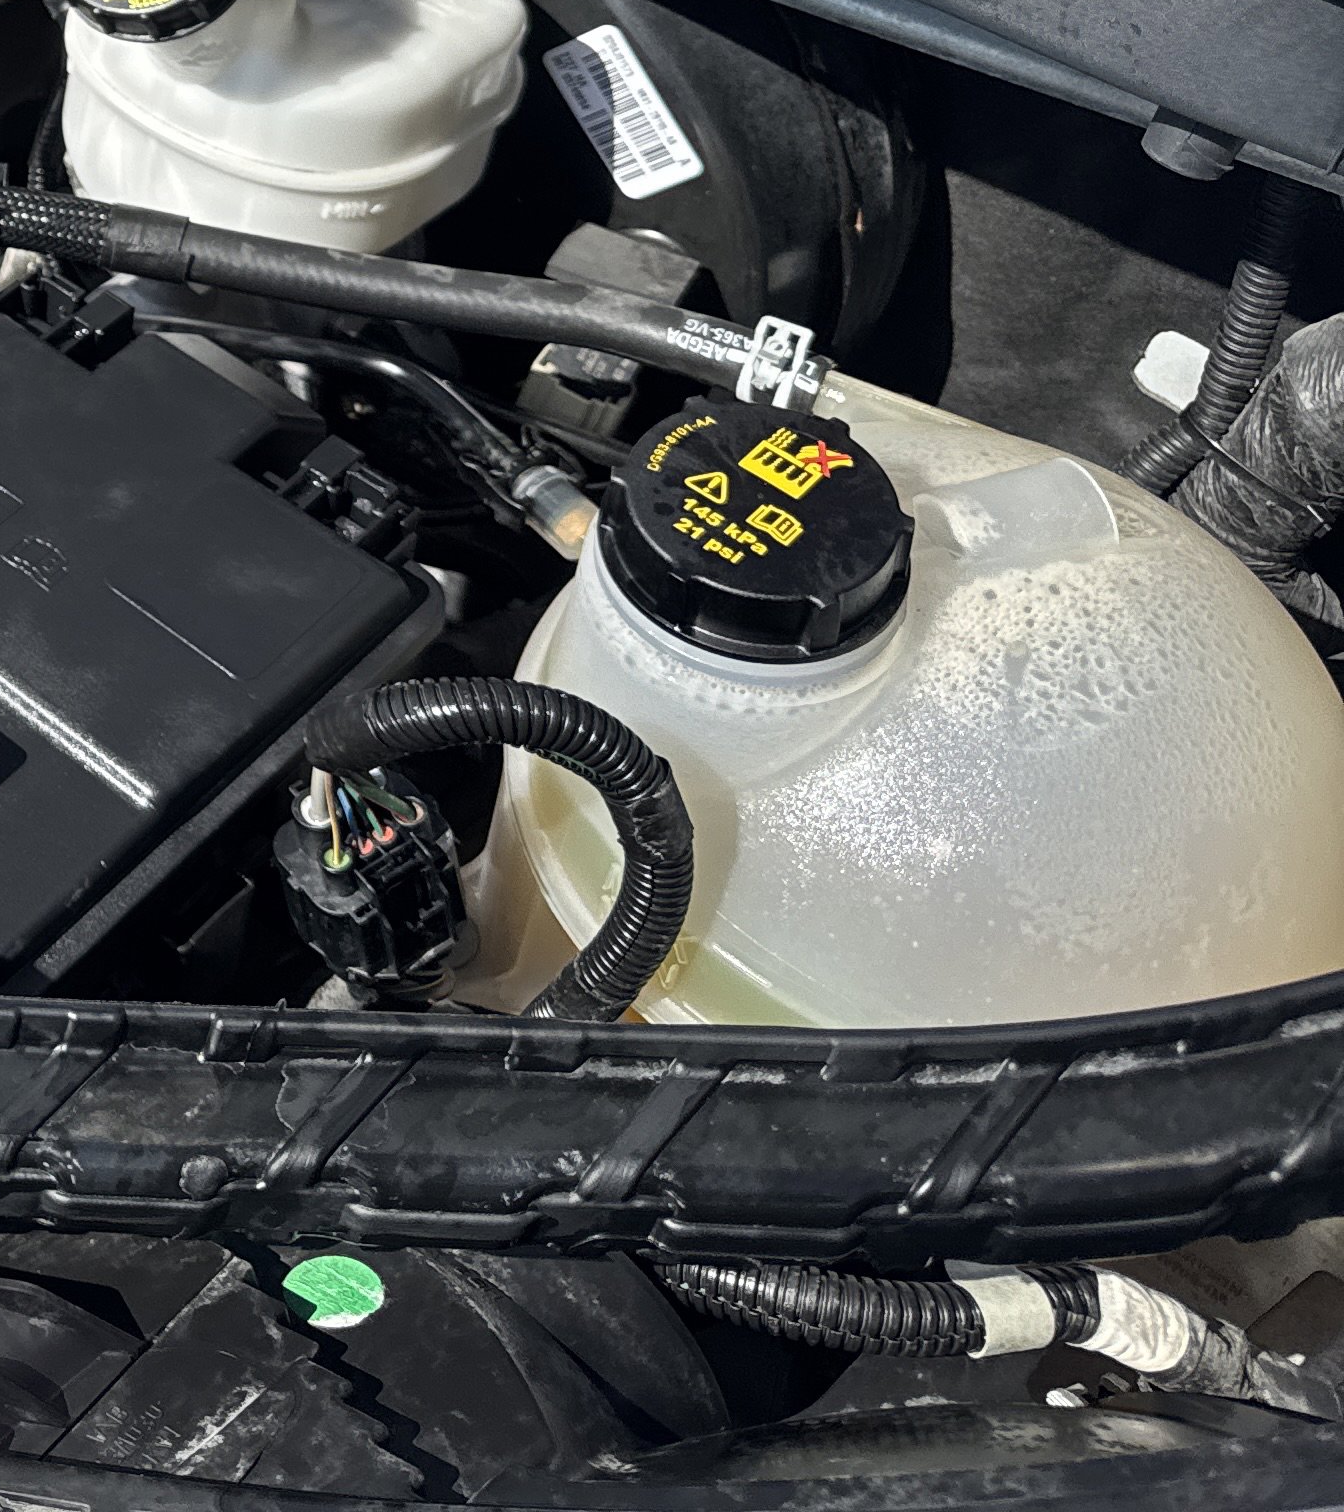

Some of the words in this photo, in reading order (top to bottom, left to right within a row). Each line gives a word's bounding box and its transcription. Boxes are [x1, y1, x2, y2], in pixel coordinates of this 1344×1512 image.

[666, 326, 728, 361] AEGDA
[673, 517, 704, 541] 21
[704, 538, 749, 566] psi
[683, 497, 725, 526] 145
[724, 521, 769, 556] kPa
